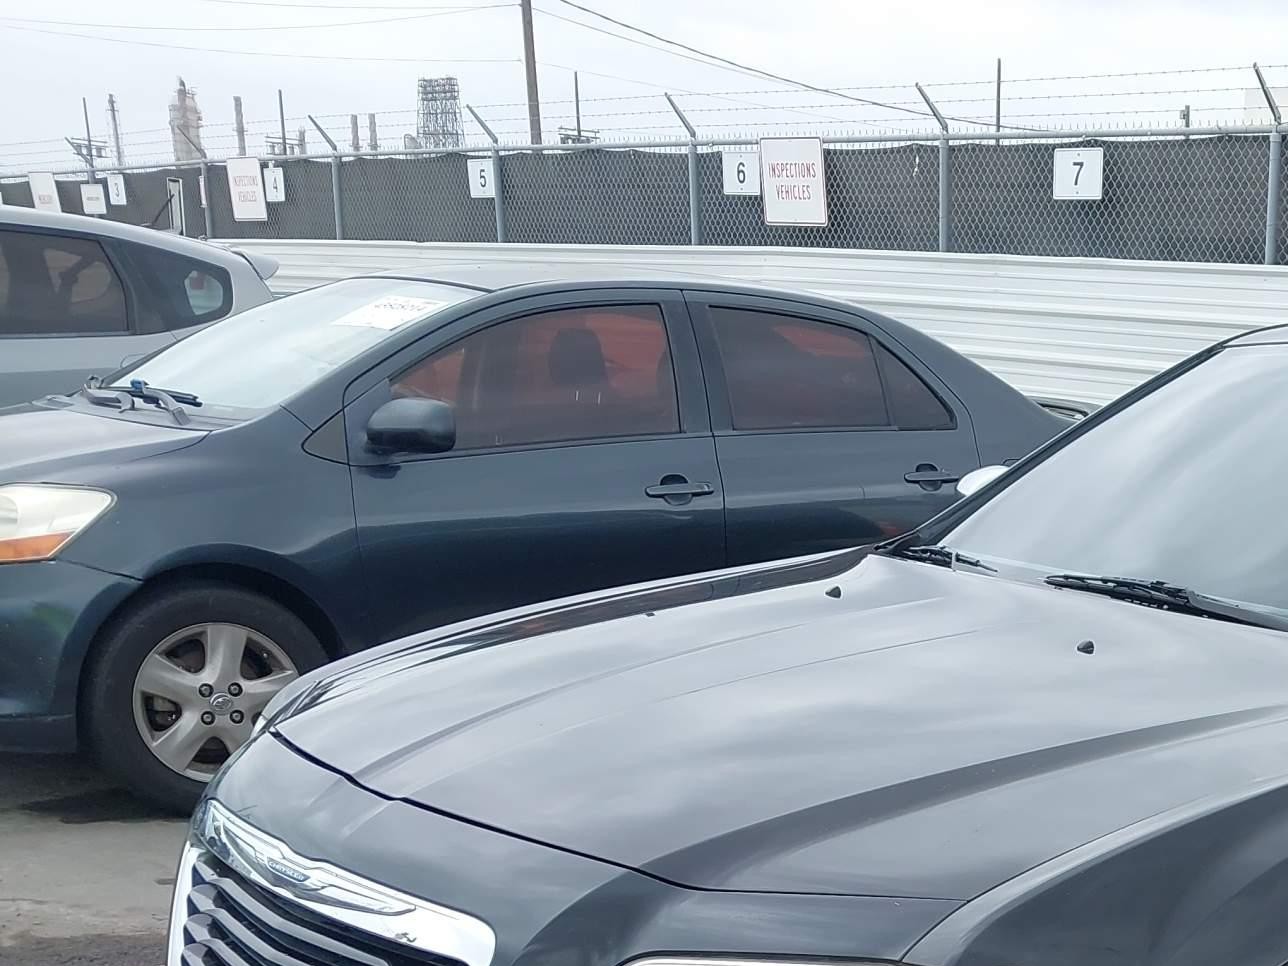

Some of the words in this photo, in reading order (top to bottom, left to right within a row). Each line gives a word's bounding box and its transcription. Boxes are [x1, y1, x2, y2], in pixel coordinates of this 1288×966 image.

[479, 168, 487, 188] 5
[736, 162, 746, 184] 6
[767, 162, 817, 178] INSPECTIONS
[1072, 161, 1084, 186] 7
[272, 176, 278, 192] 4
[775, 184, 812, 201] VEHICLES
